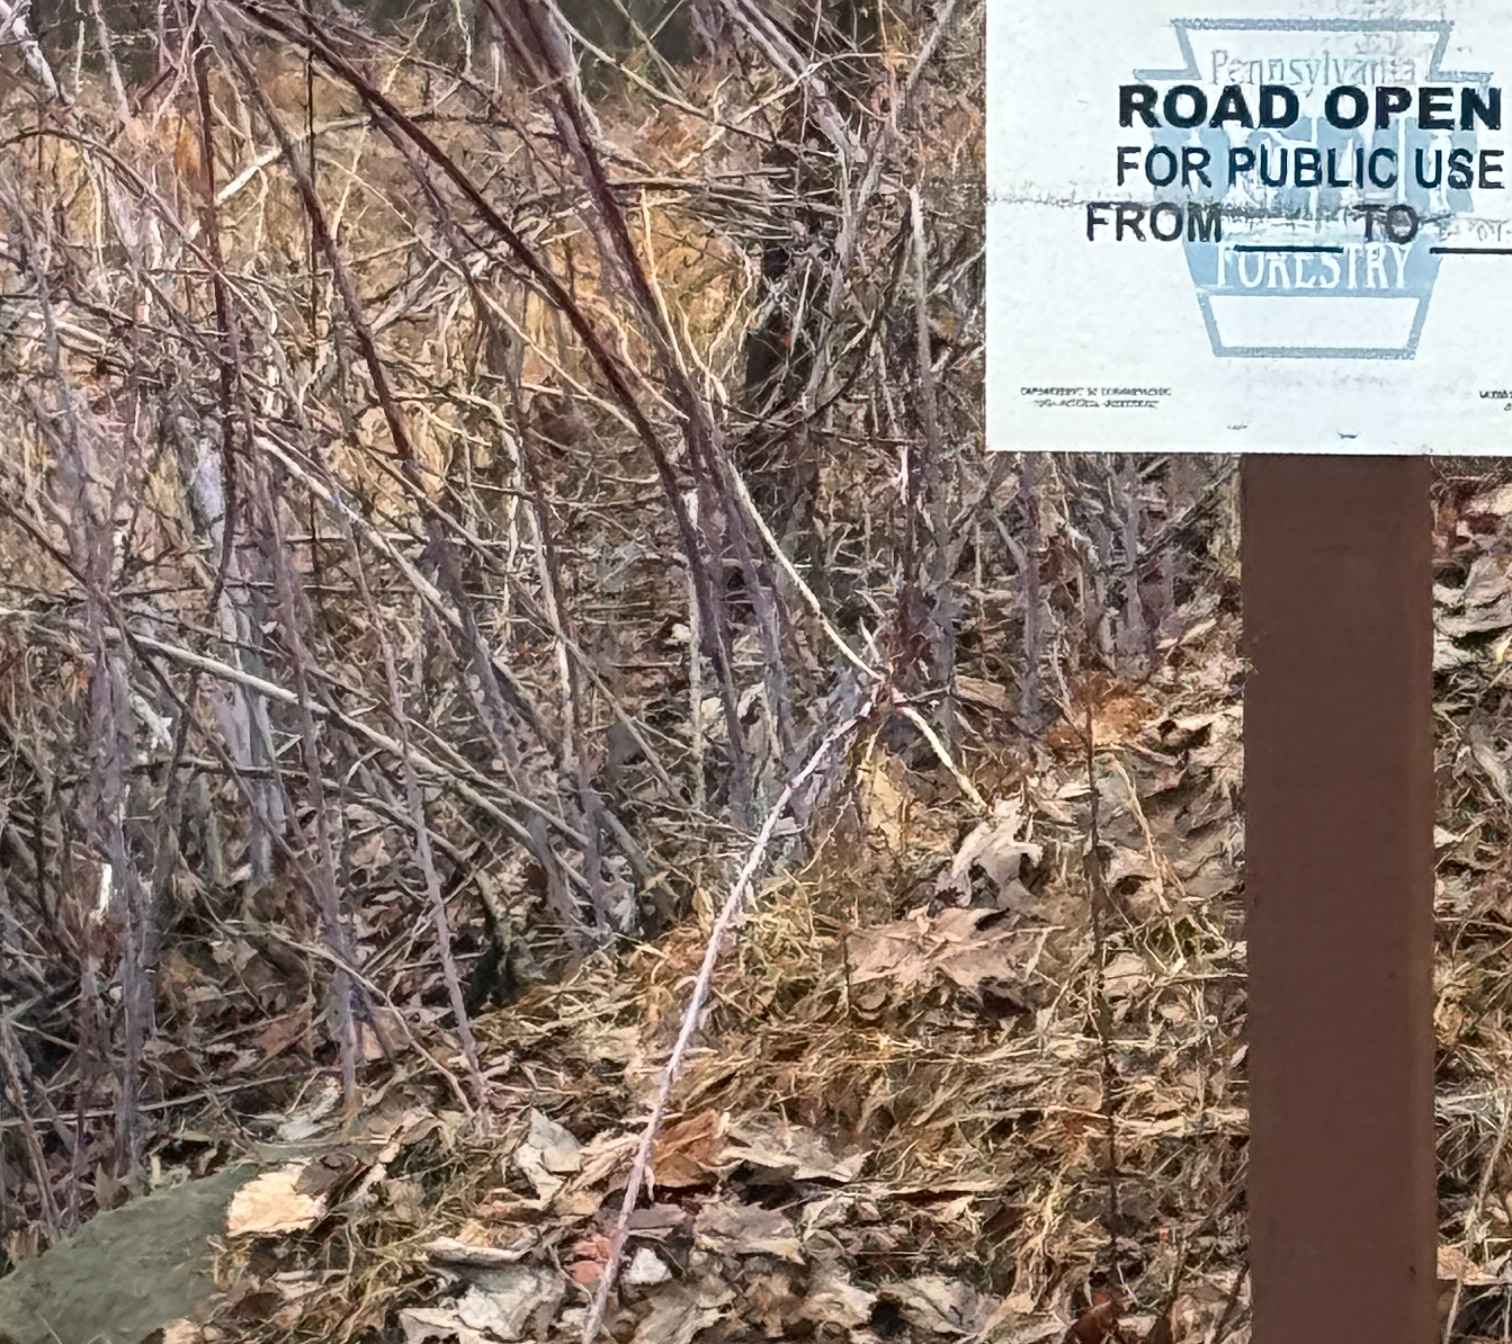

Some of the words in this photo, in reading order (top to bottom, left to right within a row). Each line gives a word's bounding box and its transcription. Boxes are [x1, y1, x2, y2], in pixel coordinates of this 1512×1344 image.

[1119, 84, 1301, 130] ROAD
[1324, 85, 1502, 130] OPEN
[1117, 145, 1213, 189] FOR
[1228, 146, 1399, 190] PUBLIC
[1415, 147, 1505, 190] USE
[1086, 202, 1222, 243] FROM
[1354, 203, 1419, 244] TO
[1216, 242, 1411, 290] FORESTRY
